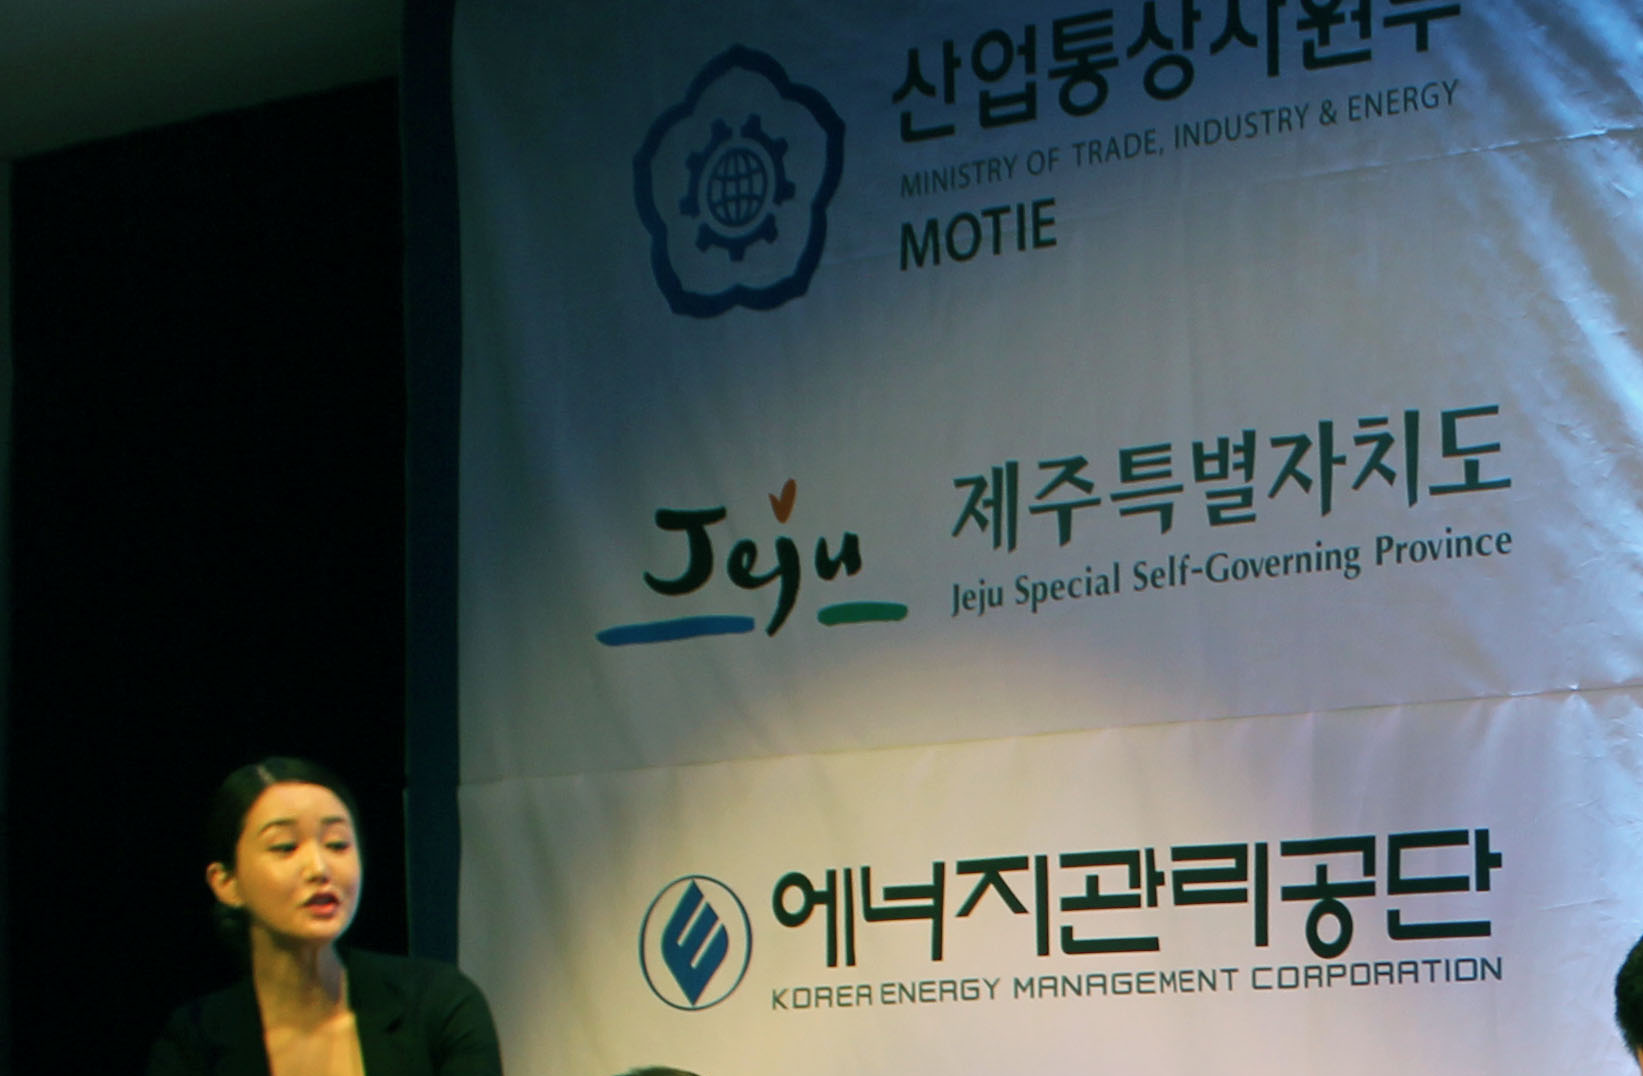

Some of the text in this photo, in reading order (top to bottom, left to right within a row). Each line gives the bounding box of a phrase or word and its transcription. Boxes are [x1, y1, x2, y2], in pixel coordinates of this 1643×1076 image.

[900, 79, 1460, 198] MINISTRY OF TRADE, INDUSTRY & ENERGY
[900, 198, 1058, 271] MOTIE
[950, 404, 1512, 553] 제주특별자치도
[642, 478, 864, 637] Jeju
[951, 526, 1513, 618] Jeju Special Self-Governing Province
[770, 828, 1503, 968] 에너지관리공단
[771, 956, 1503, 1010] KOREA ENERGY MANAGEMENT CORPORATION
